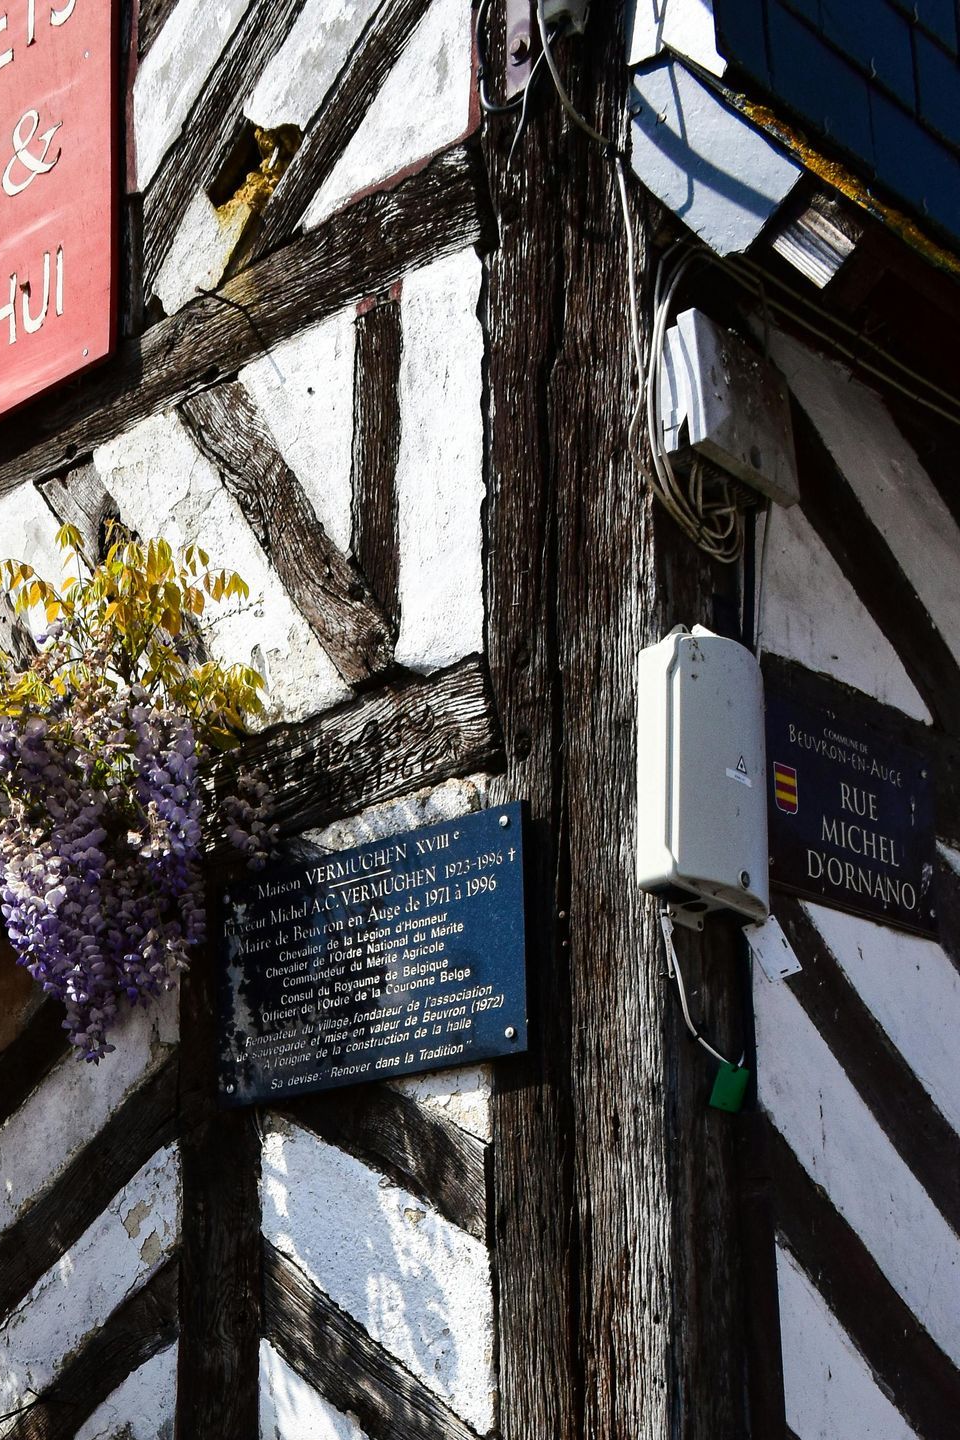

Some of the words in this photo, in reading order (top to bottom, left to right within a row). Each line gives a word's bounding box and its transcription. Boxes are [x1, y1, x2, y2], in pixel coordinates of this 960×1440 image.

[1, 109, 64, 197] &
[840, 782, 878, 821] RUE
[821, 815, 900, 868] MICHEL
[258, 879, 301, 899] Maison
[305, 843, 407, 885] VERMUGHEN
[270, 901, 307, 925] Michel
[341, 866, 437, 906] VERMUGHEN
[444, 849, 503, 879] 1923-1996
[807, 849, 917, 911] D'ORNANO
[238, 938, 271, 956] Maire
[275, 930, 289, 946] de
[293, 919, 343, 942] Beuvron
[348, 915, 362, 928] en
[368, 905, 400, 922] Auge
[405, 896, 421, 913] de
[425, 885, 450, 908] 1971
[455, 884, 462, 900] à
[466, 873, 497, 897] 1996
[279, 944, 322, 962] Chevalier
[326, 939, 339, 951] de
[344, 935, 352, 947] la
[357, 926, 390, 944] Légion
[395, 912, 448, 933] d'Honneur
[265, 961, 308, 979] Chevalier
[313, 956, 325, 968] de
[329, 947, 362, 963] l'Ordre
[367, 934, 409, 954] National
[413, 931, 426, 943] du
[431, 921, 464, 939] Mérite
[282, 965, 345, 988] Commandeur
[350, 961, 362, 972] du
[366, 951, 398, 968] Mérite
[402, 941, 445, 960] Agricole
[280, 988, 313, 1006] Consul
[318, 986, 330, 997] du
[334, 974, 380, 993] Royaume
[385, 970, 397, 981] de
[403, 958, 449, 978] Belgique
[301, 1003, 313, 1014] de
[317, 994, 349, 1011] l'Ordre
[354, 990, 367, 1002] de
[372, 987, 381, 998] la
[385, 975, 435, 995] Couronne
[440, 967, 471, 983] Belge
[252, 1039, 306, 1059] sauvegarde
[310, 1036, 320, 1046] et
[324, 1030, 348, 1044] mise
[352, 1027, 365, 1038] en
[369, 1019, 400, 1035] valeur
[404, 1014, 418, 1027] de
[422, 1005, 466, 1023] Beuvron
[471, 993, 504, 1014] (1972)
[302, 1024, 313, 1035] du
[353, 1002, 402, 1023] fondateur
[406, 1000, 420, 1012] de
[424, 984, 492, 1009] l'association
[274, 1050, 311, 1067] l'origine
[315, 1047, 328, 1059] de
[332, 1045, 341, 1055] la
[345, 1031, 409, 1053] construction
[413, 1027, 427, 1039] de
[432, 1024, 442, 1035] la
[446, 1018, 472, 1033] halle
[271, 1078, 283, 1090] Sa
[375, 1054, 400, 1069] dans
[404, 1052, 414, 1063] la
